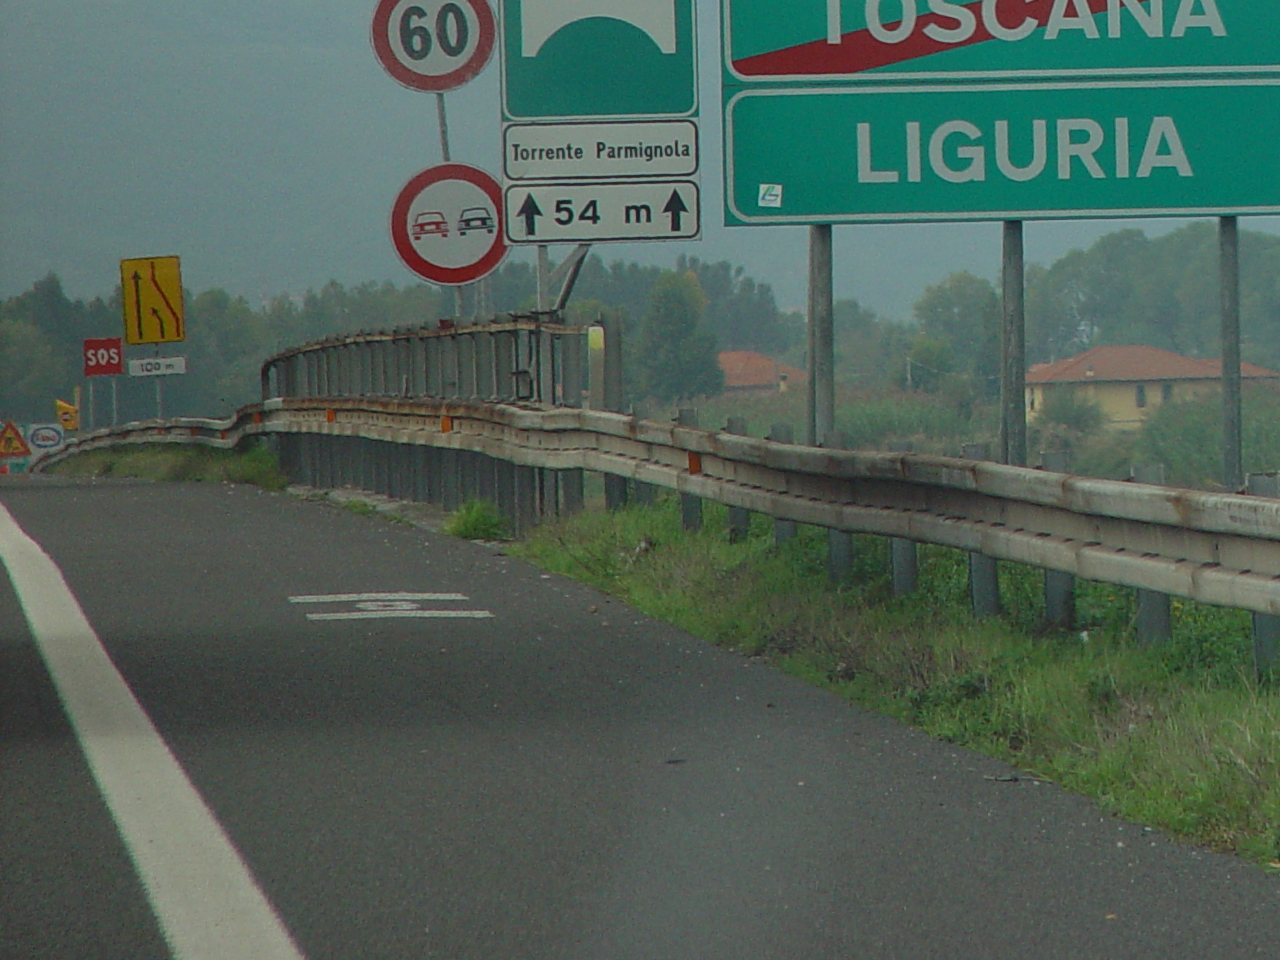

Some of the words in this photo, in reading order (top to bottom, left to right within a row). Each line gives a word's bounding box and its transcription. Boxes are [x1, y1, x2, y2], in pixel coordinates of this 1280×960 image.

[399, 2, 469, 61] 60
[511, 143, 584, 161] Torrente
[596, 140, 691, 162] Parmignola
[856, 116, 1194, 183] LIGURIA
[554, 199, 601, 226] 54
[624, 203, 652, 224] m
[86, 347, 119, 366] SOS
[140, 362, 161, 373] 100
